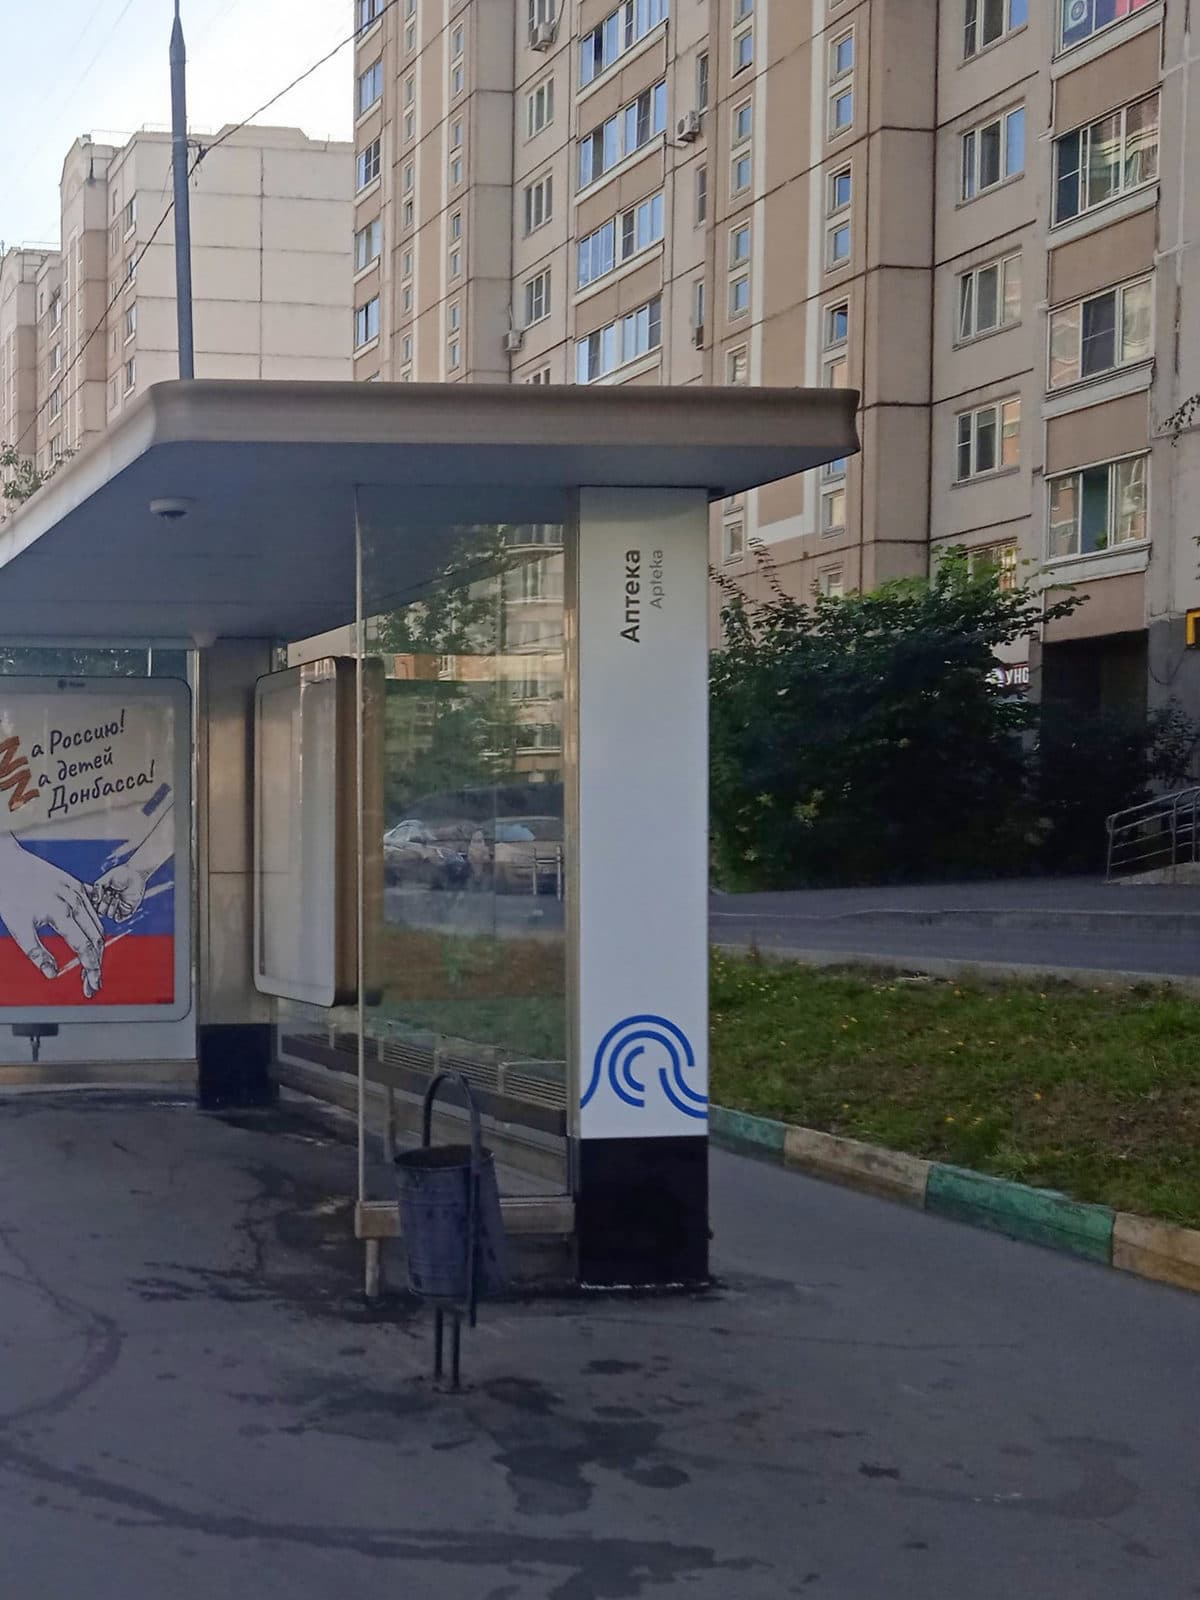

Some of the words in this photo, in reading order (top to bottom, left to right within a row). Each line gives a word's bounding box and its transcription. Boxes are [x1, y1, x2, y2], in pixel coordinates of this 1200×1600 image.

[620, 550, 641, 643] Аптека
[649, 550, 665, 609] Apteka
[49, 709, 125, 755] Россию!
[48, 759, 155, 819] Донбасса!
[57, 746, 113, 782] детей
